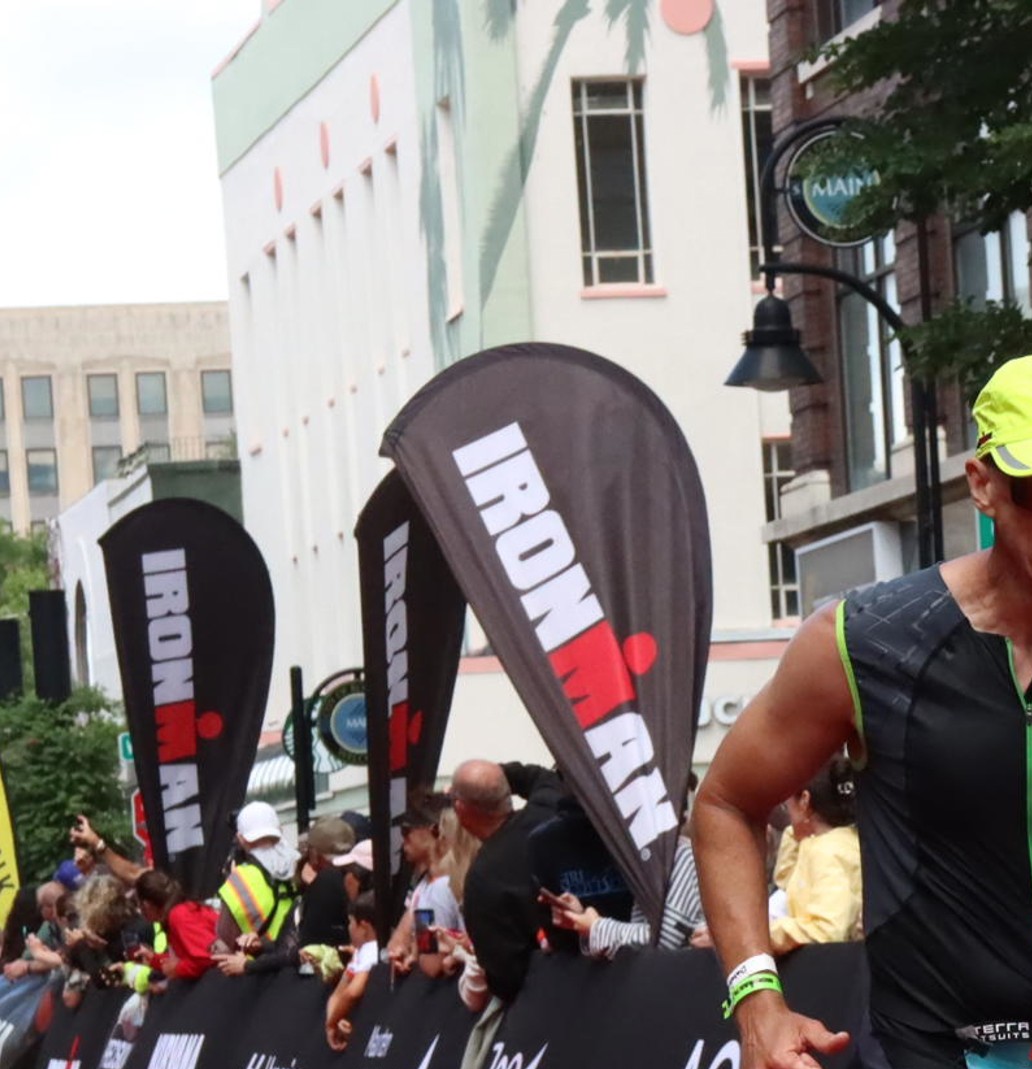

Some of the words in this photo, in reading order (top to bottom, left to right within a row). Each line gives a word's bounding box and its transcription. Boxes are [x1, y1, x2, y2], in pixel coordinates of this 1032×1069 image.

[141, 548, 205, 854] IRONMAN
[453, 420, 678, 850] IRONMAN
[974, 1022, 1029, 1035] TERRA
